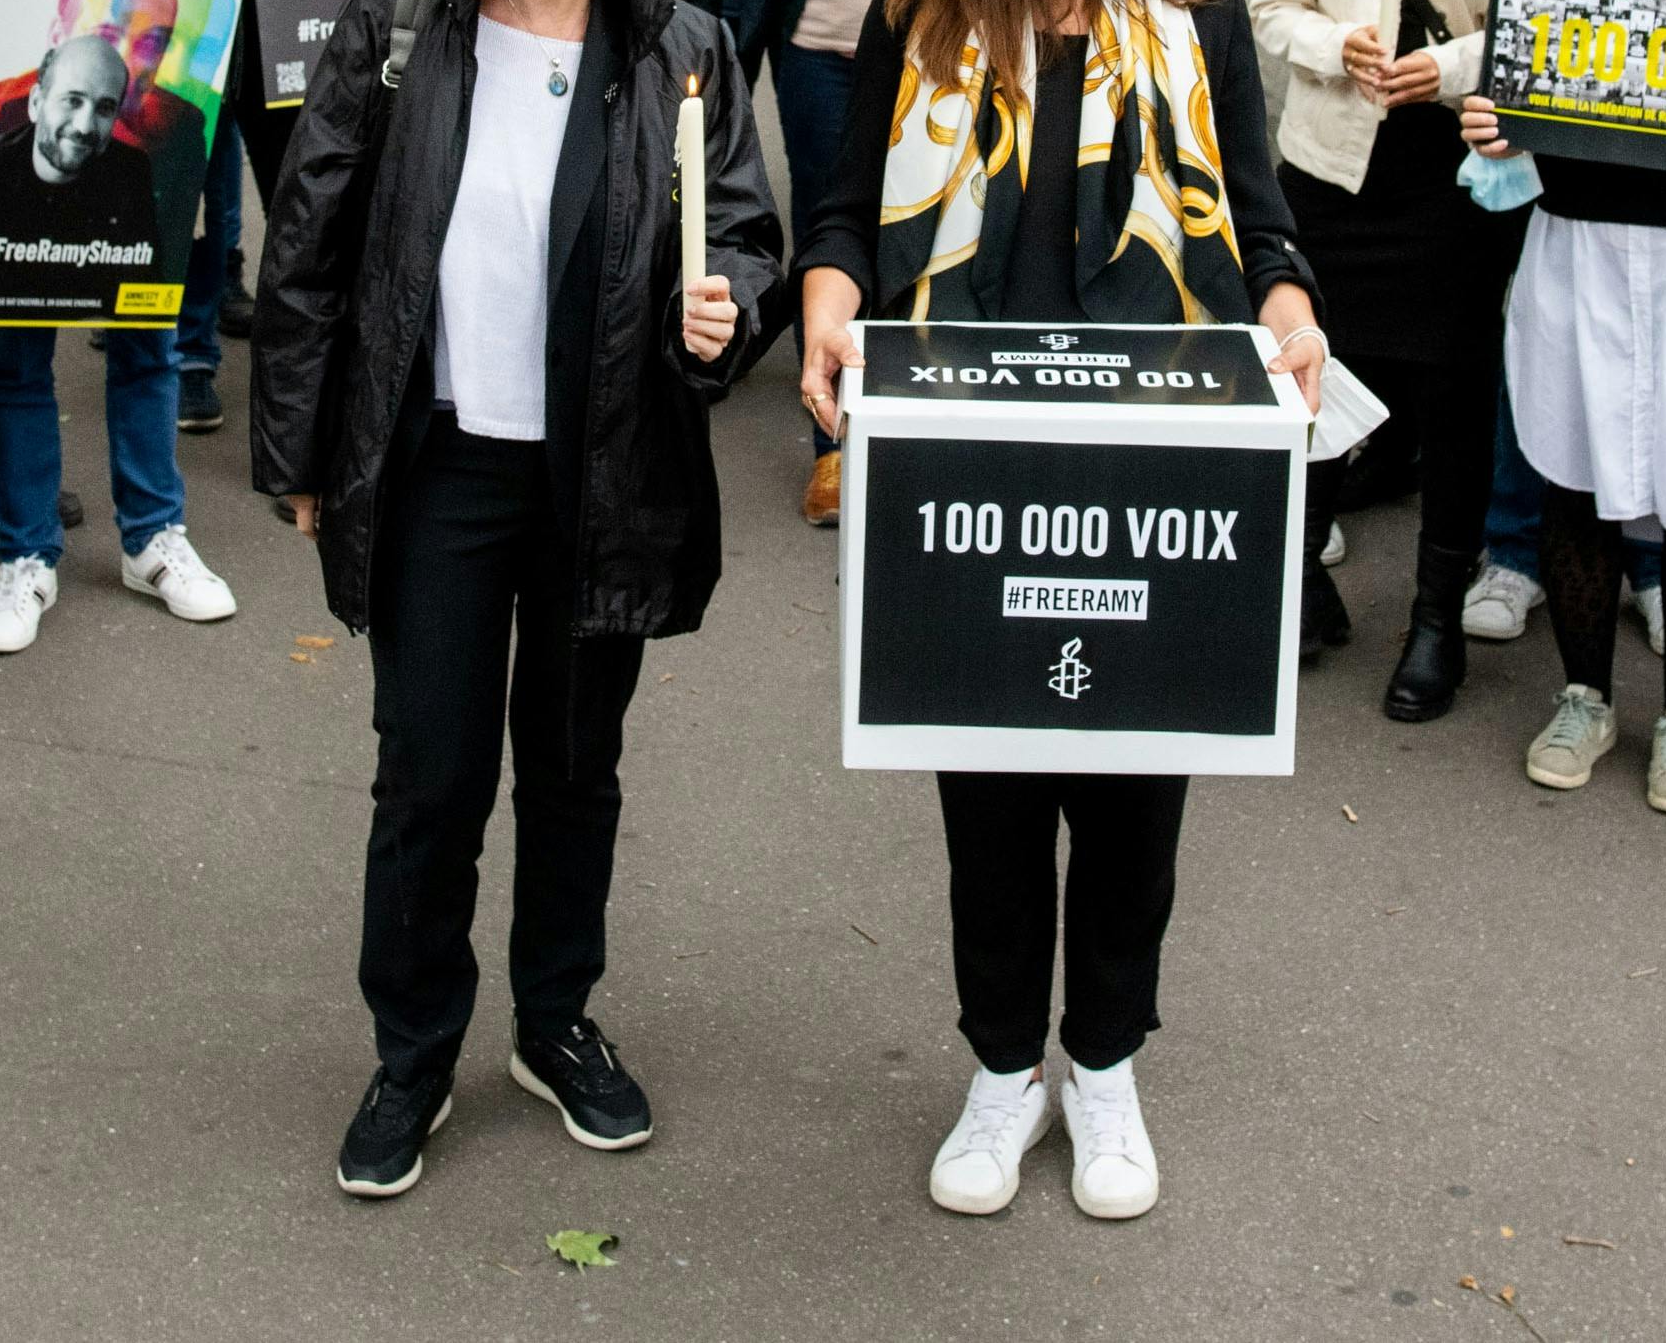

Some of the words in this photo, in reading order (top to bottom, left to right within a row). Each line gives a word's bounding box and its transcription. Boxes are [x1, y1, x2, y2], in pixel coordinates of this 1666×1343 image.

[1531, 13, 1628, 83] 100
[909, 366, 1021, 386] VOIX
[1035, 368, 1120, 388] 000
[1137, 370, 1221, 389] 100
[918, 500, 1003, 555] 100
[1020, 504, 1109, 558] 000
[1126, 507, 1239, 561] VOIX
[1007, 585, 1144, 613] #FREERAMY
